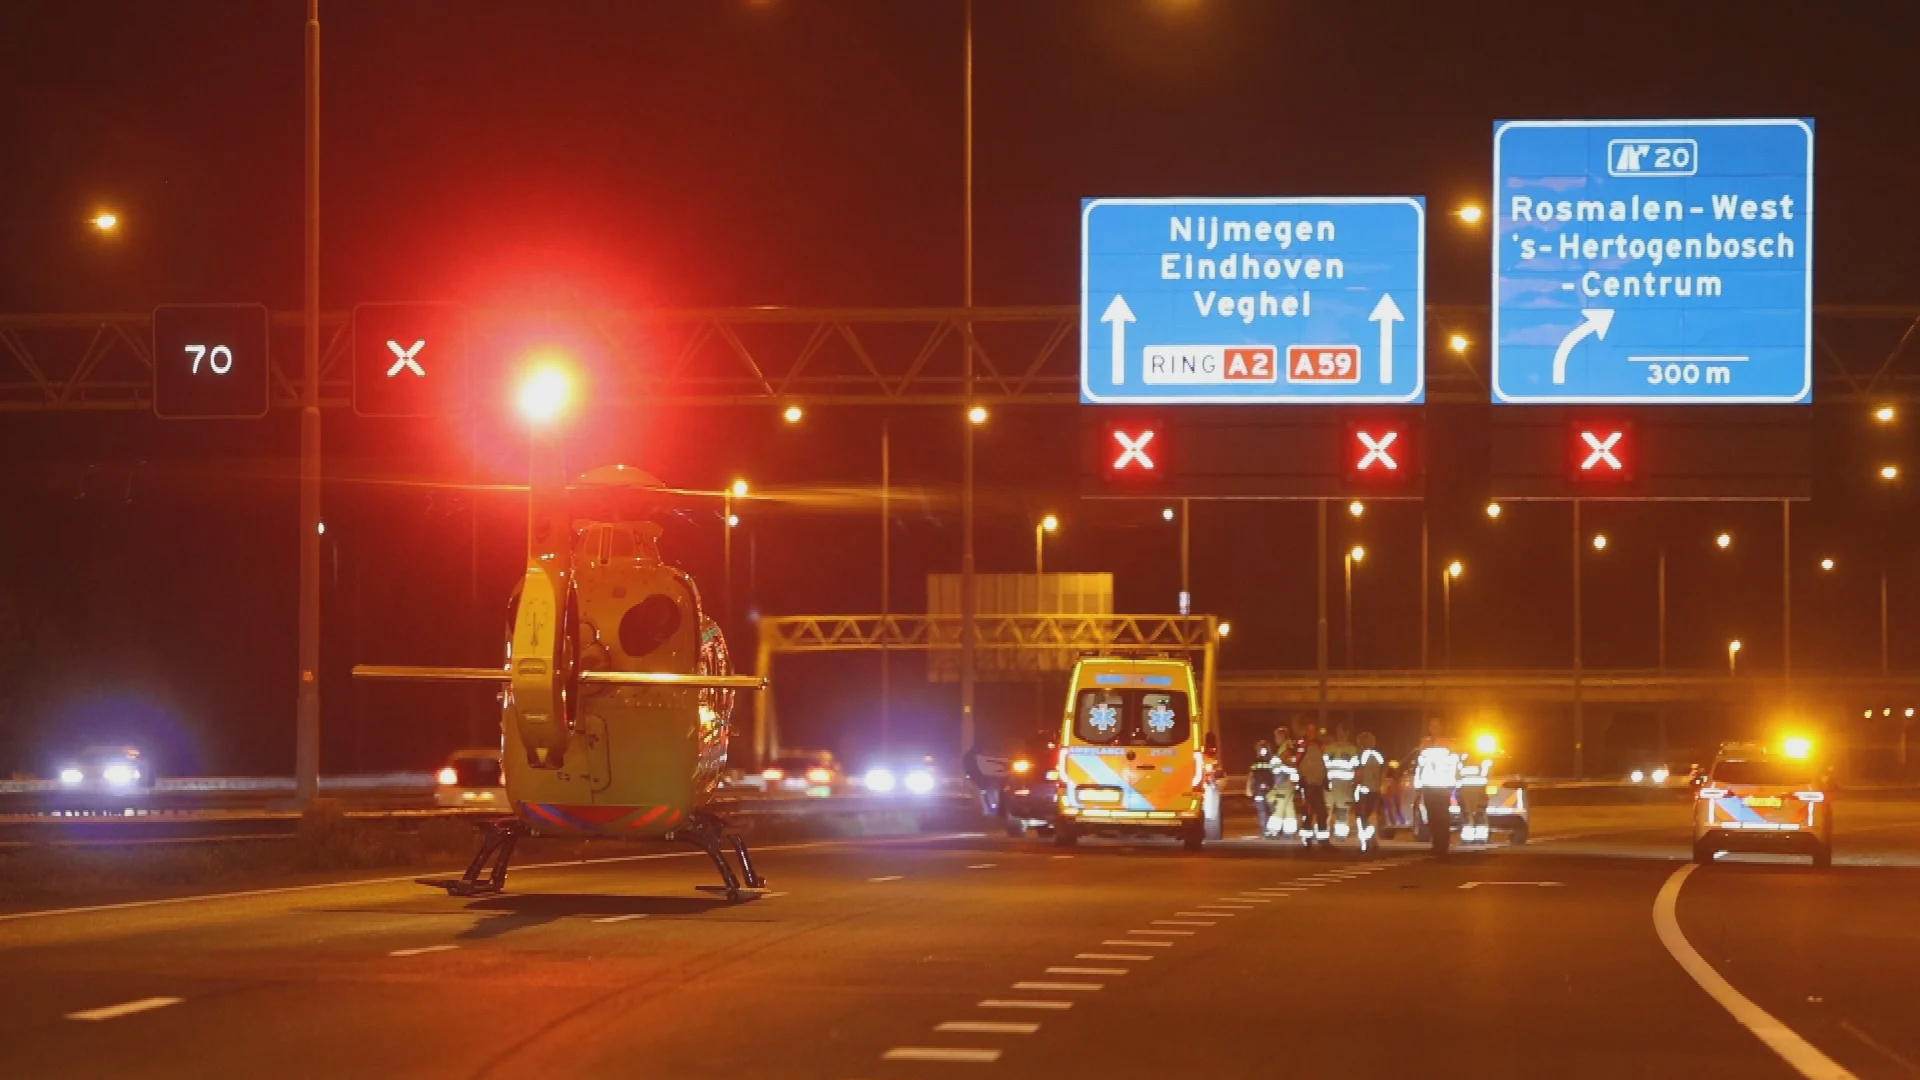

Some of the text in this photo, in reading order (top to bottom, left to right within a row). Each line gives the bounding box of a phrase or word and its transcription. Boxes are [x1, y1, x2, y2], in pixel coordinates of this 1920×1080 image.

[1654, 147, 1690, 168] 20
[1170, 216, 1336, 250] Nijmegen
[1161, 252, 1344, 280] Eindhoven
[1193, 290, 1311, 324] Veghel
[184, 344, 233, 375] 70
[1151, 352, 1269, 376] RING A2
[1294, 352, 1352, 376] A59
[1647, 363, 1730, 384] 300 m
